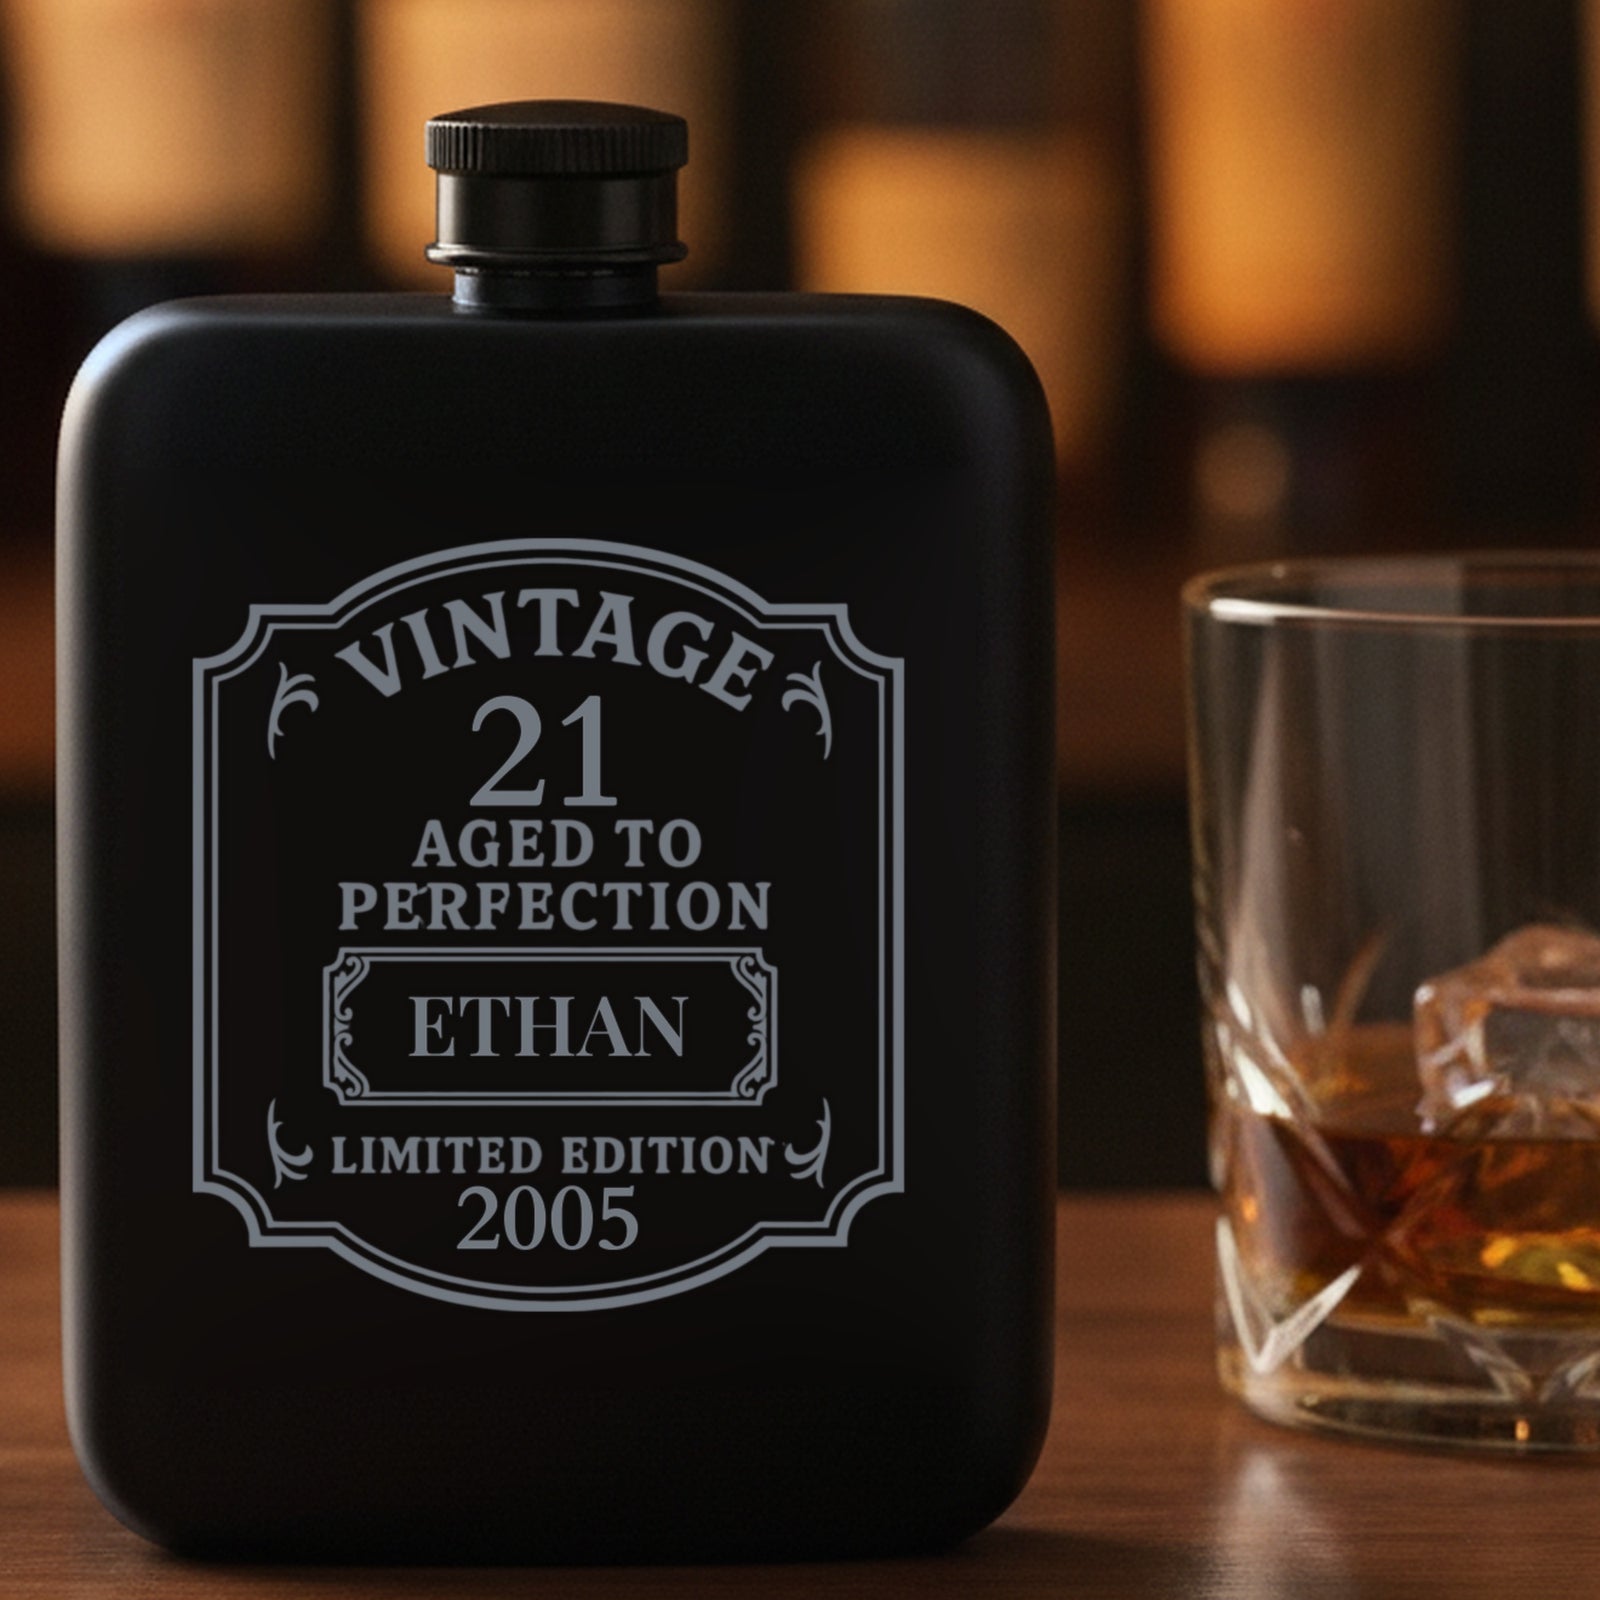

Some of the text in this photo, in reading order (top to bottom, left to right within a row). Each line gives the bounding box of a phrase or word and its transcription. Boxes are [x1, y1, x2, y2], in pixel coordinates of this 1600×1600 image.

[335, 588, 774, 711] VINTAGE
[470, 695, 617, 807] 21
[412, 818, 702, 868] AGED TO
[339, 881, 769, 931] PERFECTION
[409, 995, 689, 1057] ETHAN
[332, 1136, 774, 1175] LIMITED EDITION
[457, 1185, 638, 1251] 2005
